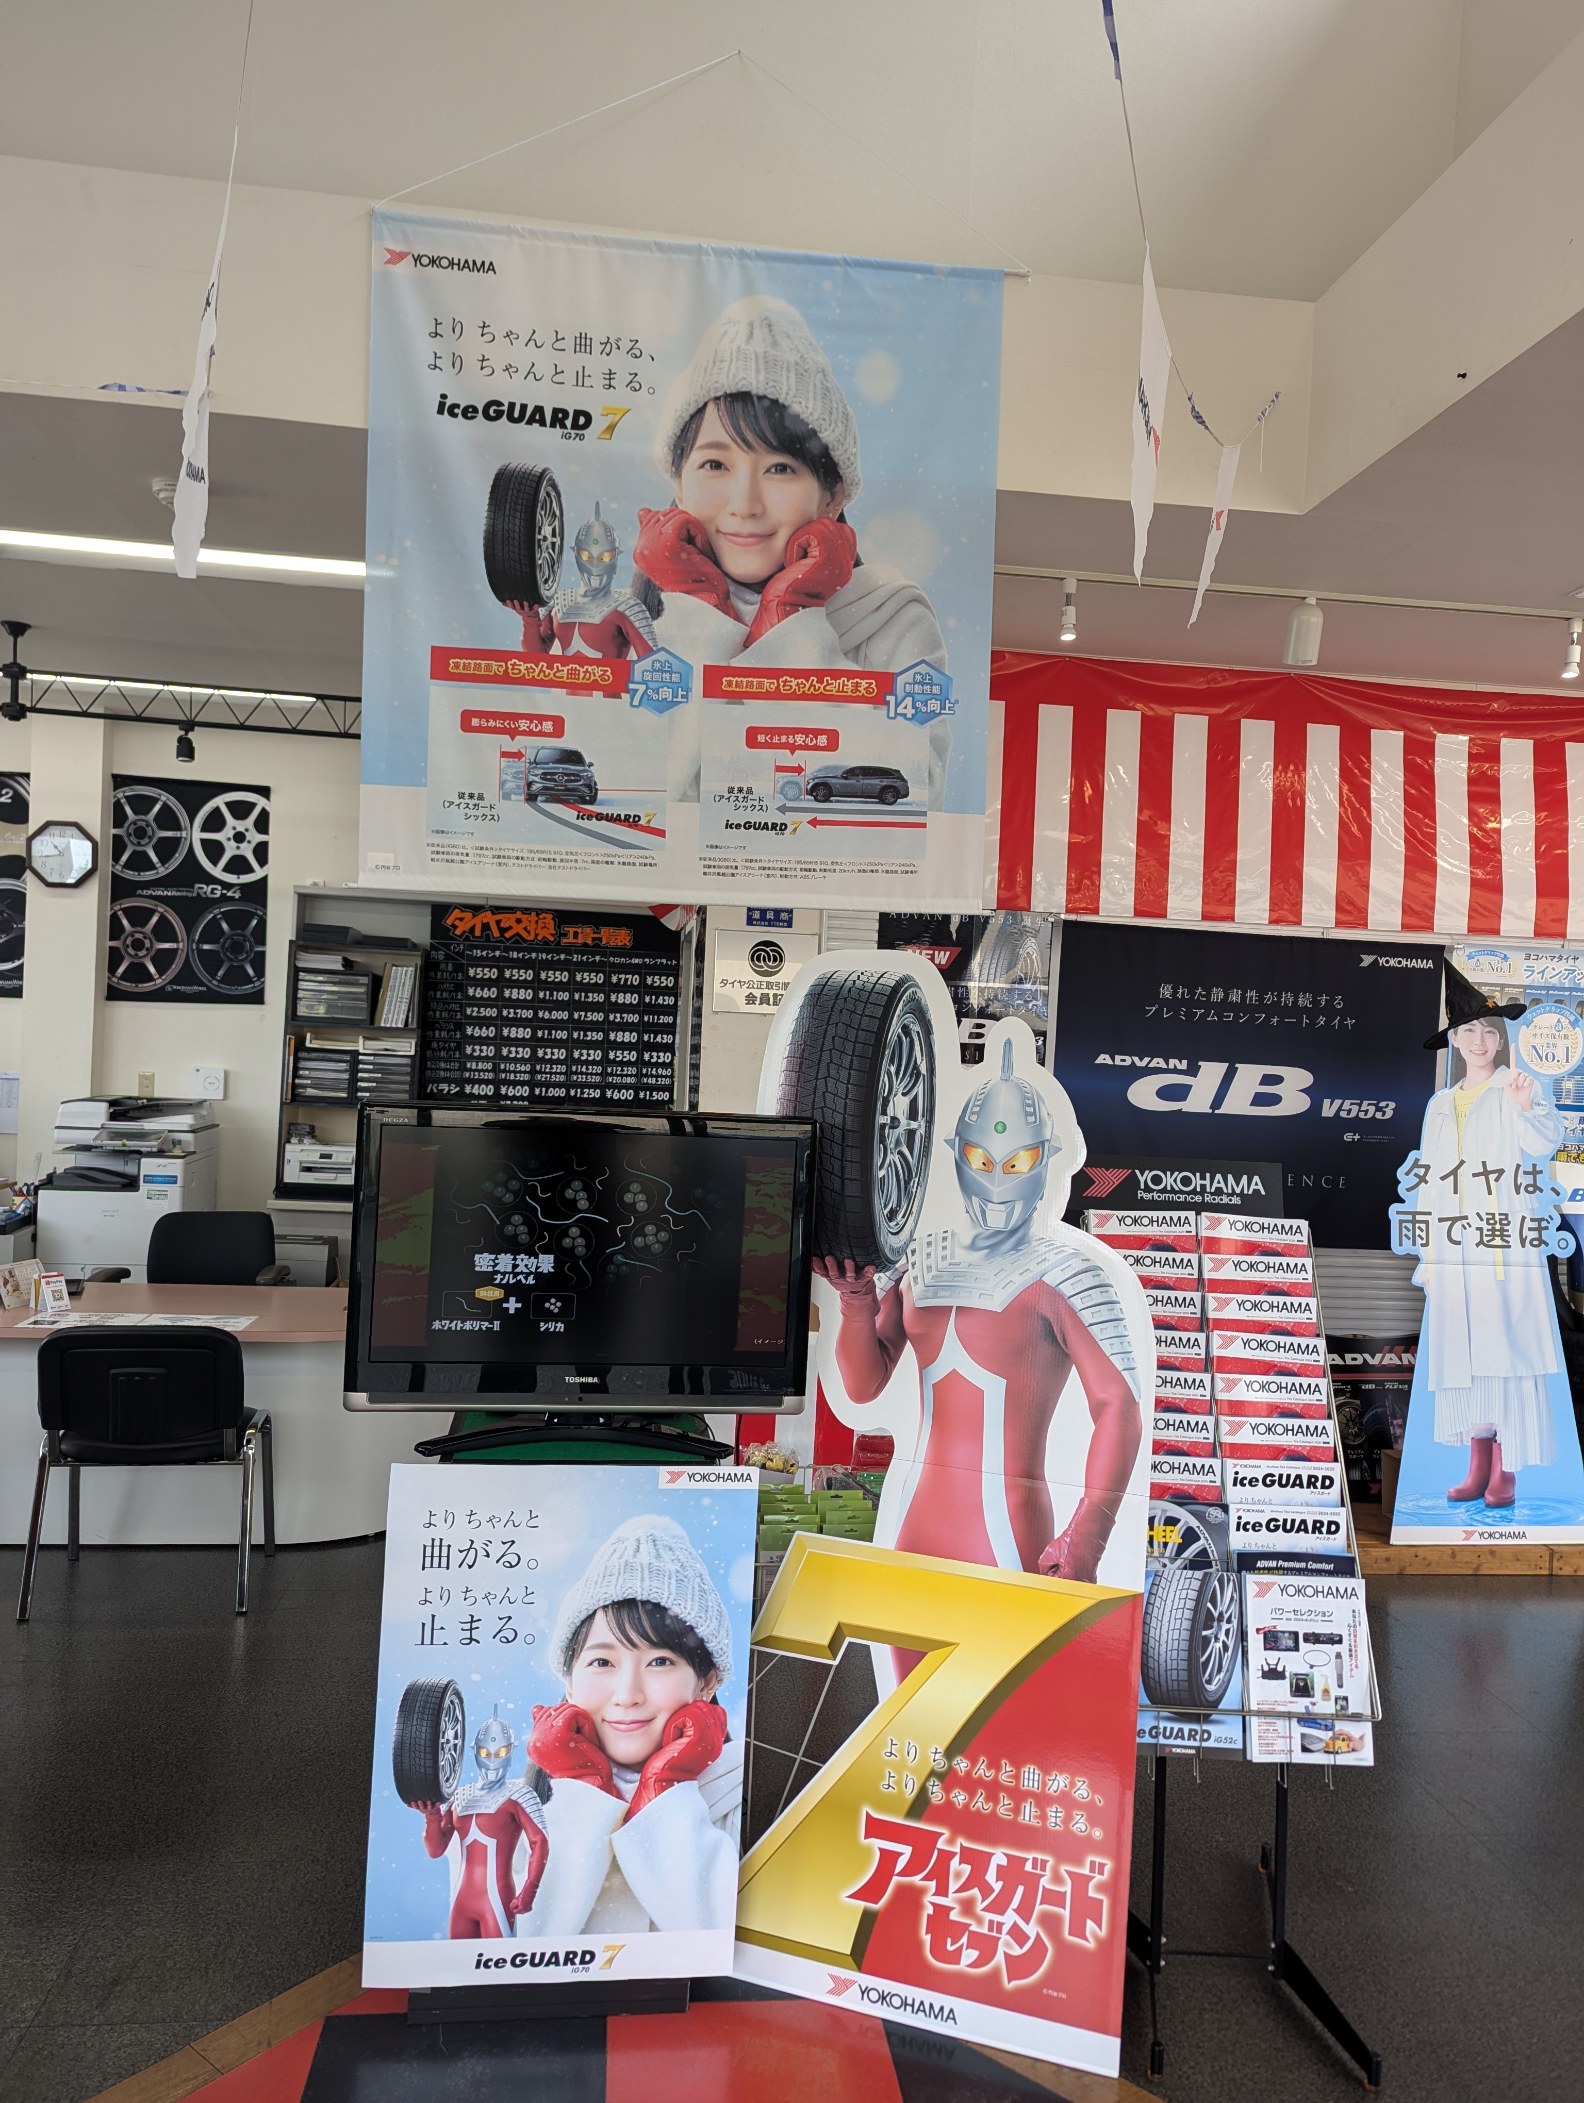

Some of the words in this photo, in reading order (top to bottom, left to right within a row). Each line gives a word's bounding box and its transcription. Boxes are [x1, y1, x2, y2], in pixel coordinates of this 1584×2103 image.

[411, 253, 497, 275] YOKOHAMA
[436, 393, 592, 431] iceGUARD
[597, 405, 631, 440] 7
[561, 431, 585, 441] iG70
[652, 660, 672, 671] 氷上
[643, 671, 681, 683] 旋回性能
[914, 673, 932, 683] 氷上
[905, 684, 941, 695] 制動性能
[471, 717, 554, 732] 膨らみにくい安心感
[757, 733, 827, 746] 短く止まる安心感
[457, 791, 485, 801] 従来品
[727, 786, 754, 795] 従来品
[576, 811, 641, 824] iceGUARD
[725, 819, 788, 832] iceGUARD
[193, 883, 242, 899] RG-4
[446, 908, 557, 942] タイヤ交換
[562, 926, 632, 946] 工賃一覧表
[644, 958, 677, 966] ランフラット
[1378, 956, 1433, 969] YOKOHAMA
[1524, 953, 1580, 964] ヨコハマタイヤ
[468, 967, 498, 979] ¥550
[504, 969, 533, 980] ¥550
[540, 970, 569, 982] ¥550
[576, 972, 604, 984] ¥550
[611, 973, 640, 986] ¥770
[646, 975, 674, 987] ¥550
[467, 986, 498, 998] ¥660
[503, 988, 533, 1000] ¥880
[538, 991, 570, 1001] ¥1.100
[574, 992, 604, 1002] ¥1.350
[610, 992, 639, 1004] ¥880
[644, 995, 675, 1005] ¥1.430
[1158, 983, 1345, 1009] 優れた静粛性が持続する
[466, 1006, 498, 1017] ¥2.500
[502, 1008, 533, 1019] ¥3.700
[537, 1010, 569, 1020] ¥6.000
[573, 1011, 604, 1021] ¥7.500
[609, 1013, 639, 1023] ¥3.700
[644, 1015, 674, 1024] ¥11.200
[1145, 1004, 1356, 1030] プレミアムコンフォートタイヤ
[466, 1025, 496, 1037] ¥660
[502, 1027, 532, 1039] ¥880
[537, 1030, 568, 1040] ¥1.100
[572, 1030, 603, 1040] ¥1.350
[609, 1031, 638, 1042] ¥880
[643, 1033, 673, 1043] ¥1.430
[465, 1044, 495, 1056] ¥330
[502, 1046, 531, 1058] ¥330
[537, 1048, 566, 1060] ¥330
[573, 1049, 602, 1060] ¥330
[608, 1050, 637, 1061] ¥550
[643, 1051, 672, 1063] ¥330
[1094, 1053, 1188, 1070] ADVAN
[1529, 1044, 1573, 1064] No.1
[427, 1084, 460, 1093] バラシ
[465, 1083, 494, 1095] ¥400
[500, 1085, 529, 1097] ¥600
[535, 1087, 566, 1097] ¥1.000
[570, 1088, 600, 1098] ¥1.250
[606, 1089, 634, 1100] ¥600
[639, 1091, 670, 1100] ¥1.500
[1127, 1061, 1314, 1117] dB
[1321, 1098, 1396, 1120] V553
[1135, 1169, 1266, 1196] YOKOHAMA
[1404, 1157, 1561, 1196] タイヤは、
[1138, 1190, 1201, 1203] Performance
[1204, 1192, 1242, 1205] Radials
[1116, 1215, 1192, 1228] YOKOHAMA
[1227, 1218, 1304, 1237] YOKOHAMA
[1396, 1210, 1569, 1250] 雨で選ぼ。
[473, 1252, 555, 1273] 密着効果
[1232, 1260, 1308, 1275] YOKOHAMA
[1236, 1298, 1313, 1314] YOKOHAMA
[539, 1322, 565, 1332] シリカ
[1241, 1338, 1320, 1356] YOKOHAMA
[1244, 1380, 1322, 1396] YOKOHAMA
[1249, 1422, 1330, 1438] YOKOHAMA
[1151, 1460, 1216, 1477] KOHAMA
[687, 1472, 753, 1484] YOKOHAMA
[1232, 1471, 1335, 1490] iceGUARD
[1235, 1515, 1341, 1535] iceGUARD
[1477, 1529, 1527, 1540] YOKOHAMA
[421, 1537, 539, 1572] 曲がる。
[1256, 1560, 1277, 1568] ADVAN
[1278, 1560, 1306, 1569] Premium
[1307, 1561, 1334, 1570] Comfort
[1277, 1583, 1359, 1600] YOKOHAMA
[1270, 1608, 1333, 1618] パワーセレクション
[414, 1614, 536, 1647] 止まる。
[1213, 1735, 1238, 1745] iG52c
[844, 1809, 1110, 1948] アイスガード
[924, 1901, 1052, 1986] セブン
[475, 1949, 596, 1970] iceGUARD
[598, 1943, 627, 1970] 7
[571, 1966, 590, 1974] iG70
[858, 1983, 957, 2025] YOKOHAMA
